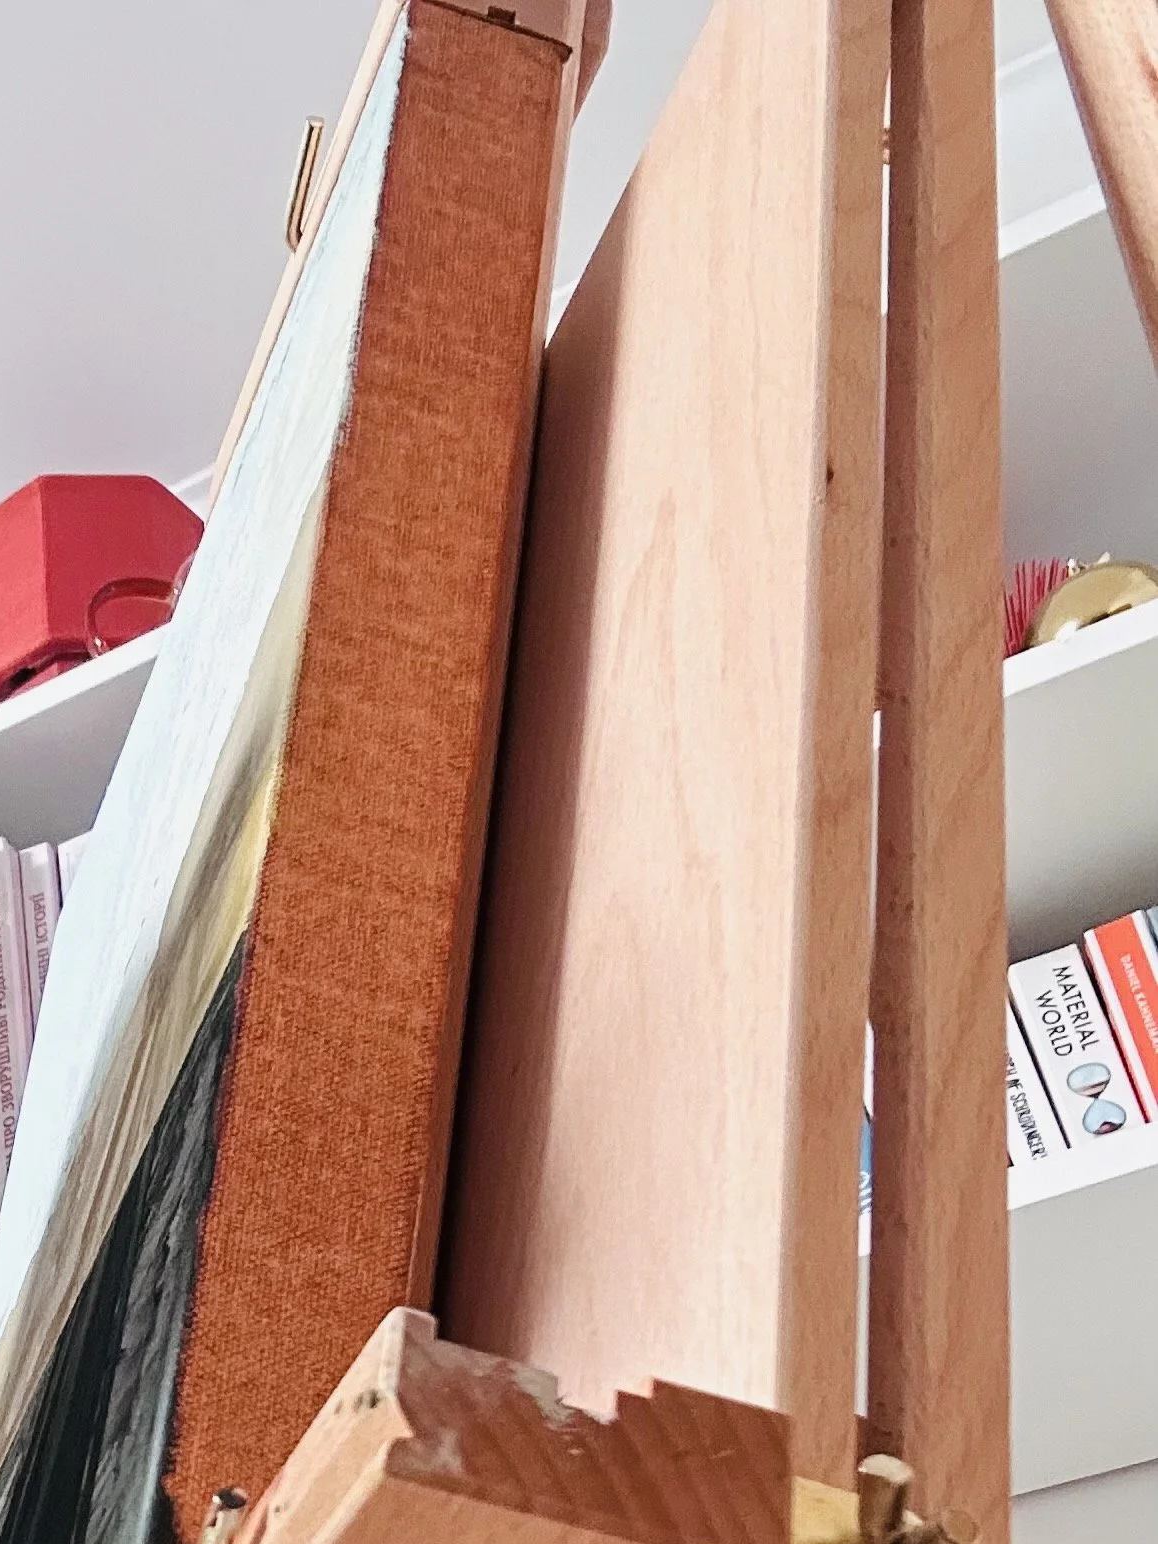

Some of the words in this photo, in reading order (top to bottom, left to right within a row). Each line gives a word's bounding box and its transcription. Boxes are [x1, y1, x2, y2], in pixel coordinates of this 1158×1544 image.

[1120, 953, 1140, 993] DANIEL
[1035, 989, 1073, 1057] WORLD
[1052, 966, 1100, 1051] MATERIAL
